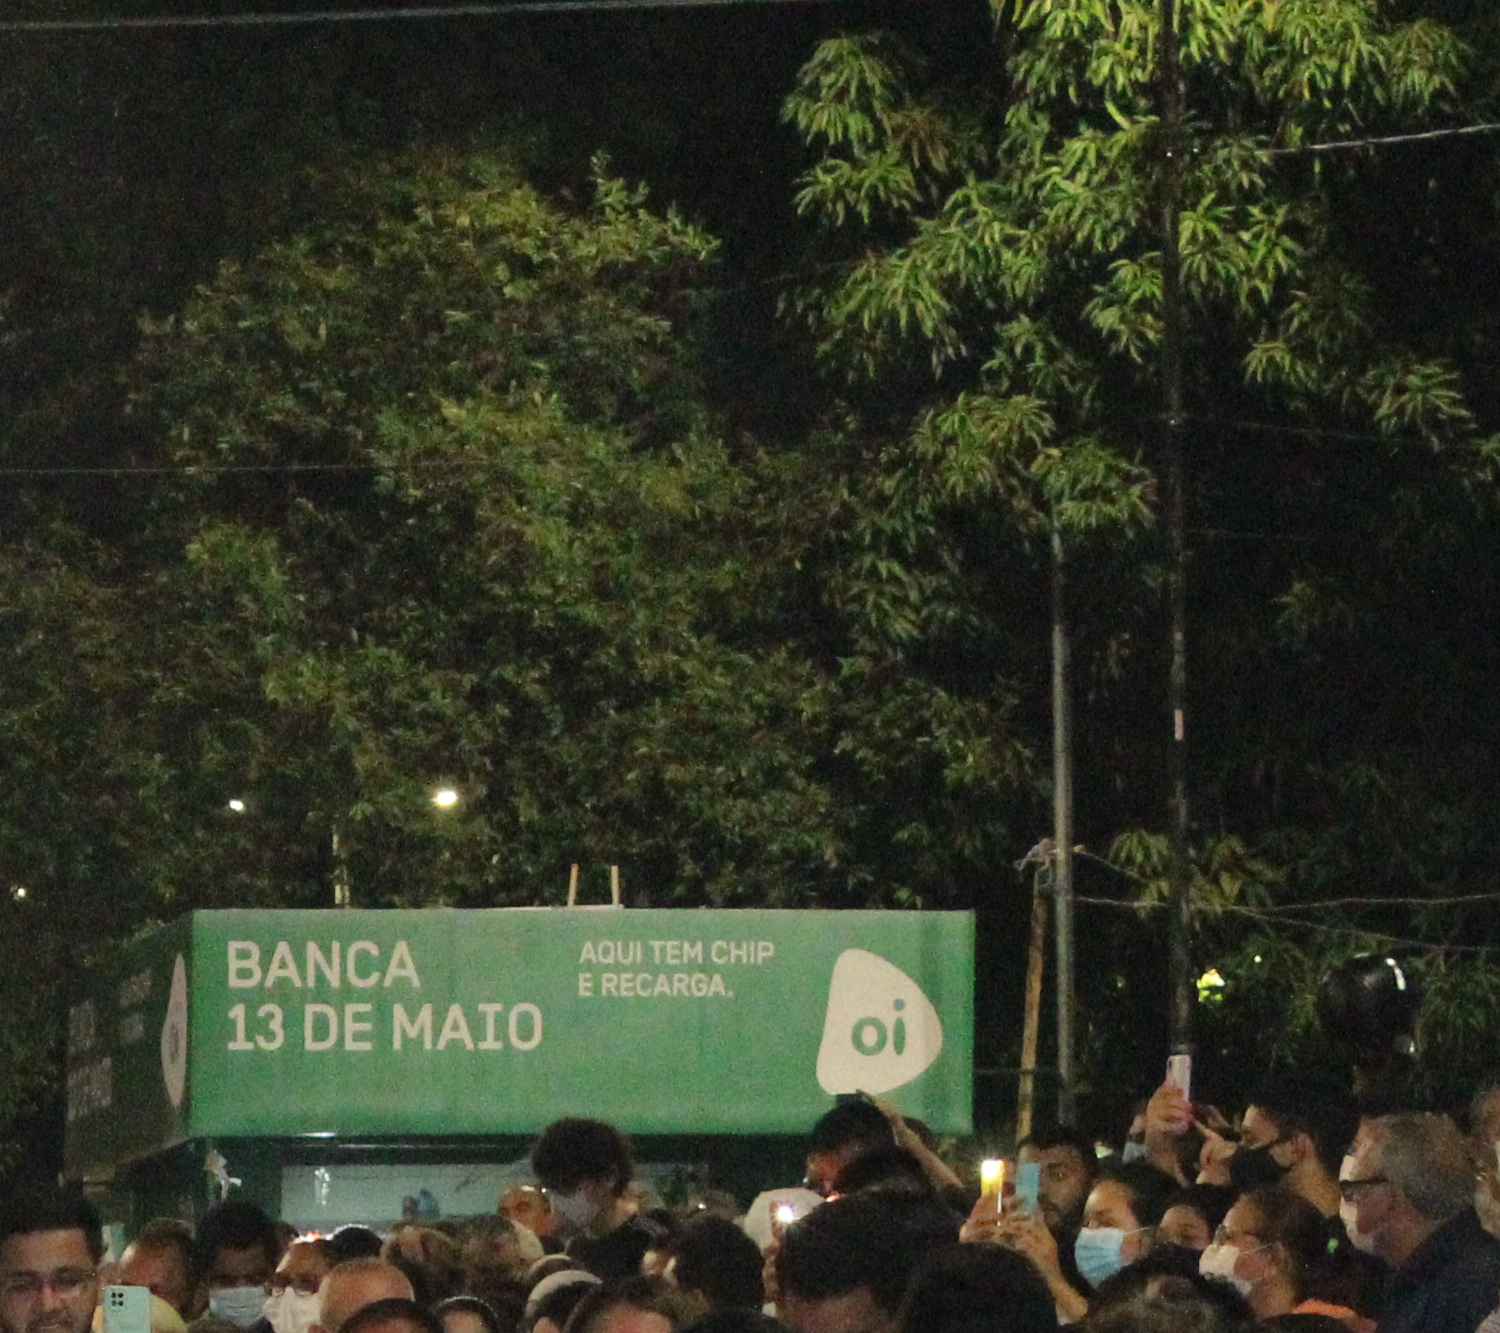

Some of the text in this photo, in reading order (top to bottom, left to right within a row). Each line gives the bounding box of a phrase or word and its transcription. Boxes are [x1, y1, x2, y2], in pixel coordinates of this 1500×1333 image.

[227, 939, 421, 988] BANCA
[579, 940, 776, 965] AQUI TEM CHIP
[578, 973, 734, 997] E RECARGA.
[227, 1002, 285, 1050] 13
[304, 1002, 373, 1050] DE
[392, 1002, 543, 1050] MAIO
[851, 997, 906, 1056] oi
